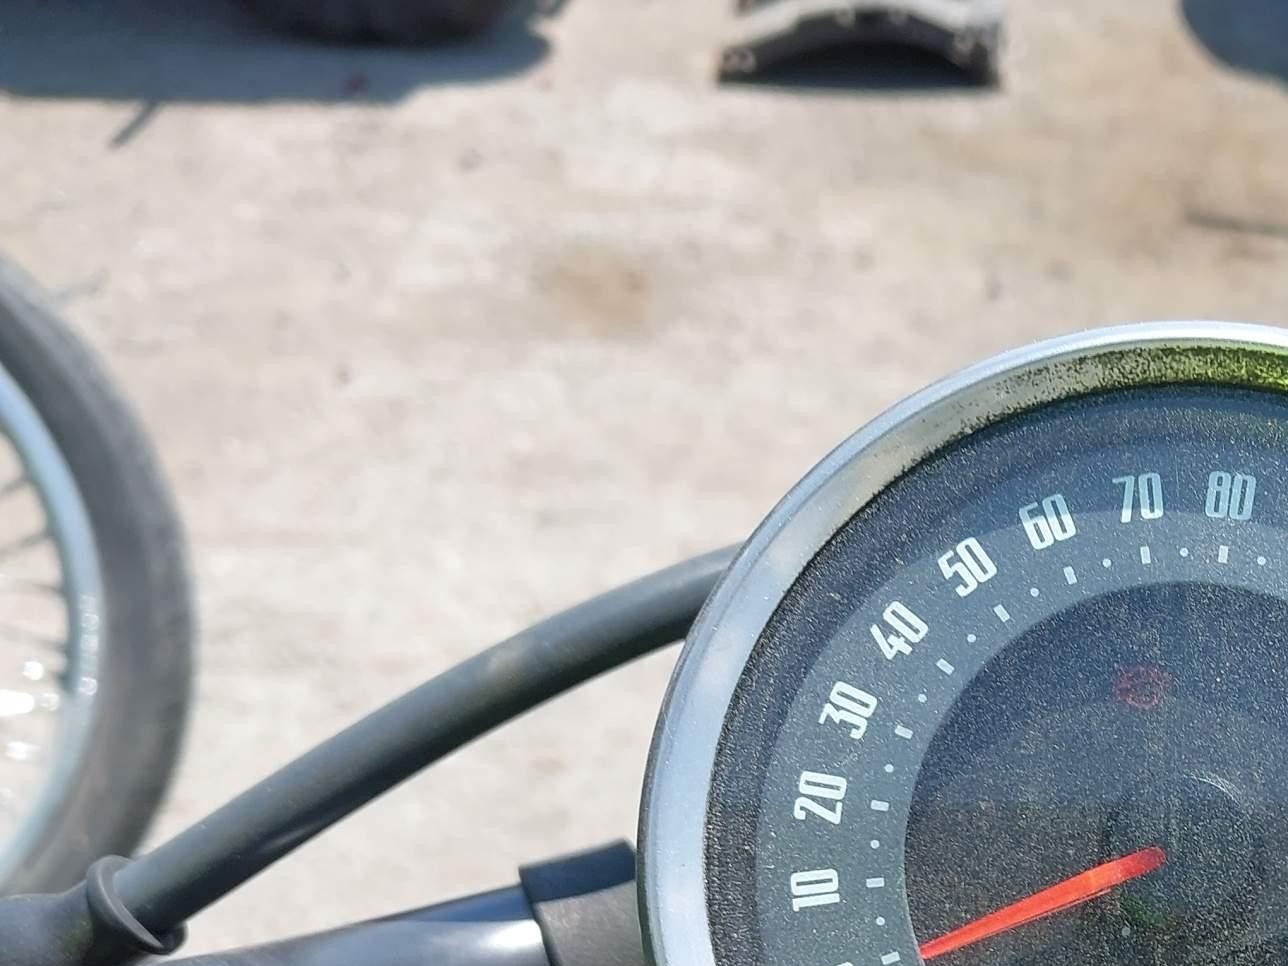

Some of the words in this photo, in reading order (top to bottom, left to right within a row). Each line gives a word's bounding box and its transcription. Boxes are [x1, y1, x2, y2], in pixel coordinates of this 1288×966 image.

[1018, 494, 1076, 549] 60
[1112, 473, 1164, 523] 70
[1204, 470, 1256, 521] 80
[937, 537, 997, 597] 50
[870, 601, 929, 660] 40
[818, 681, 878, 740] 30
[794, 771, 848, 825] 20
[790, 868, 840, 912] 10
